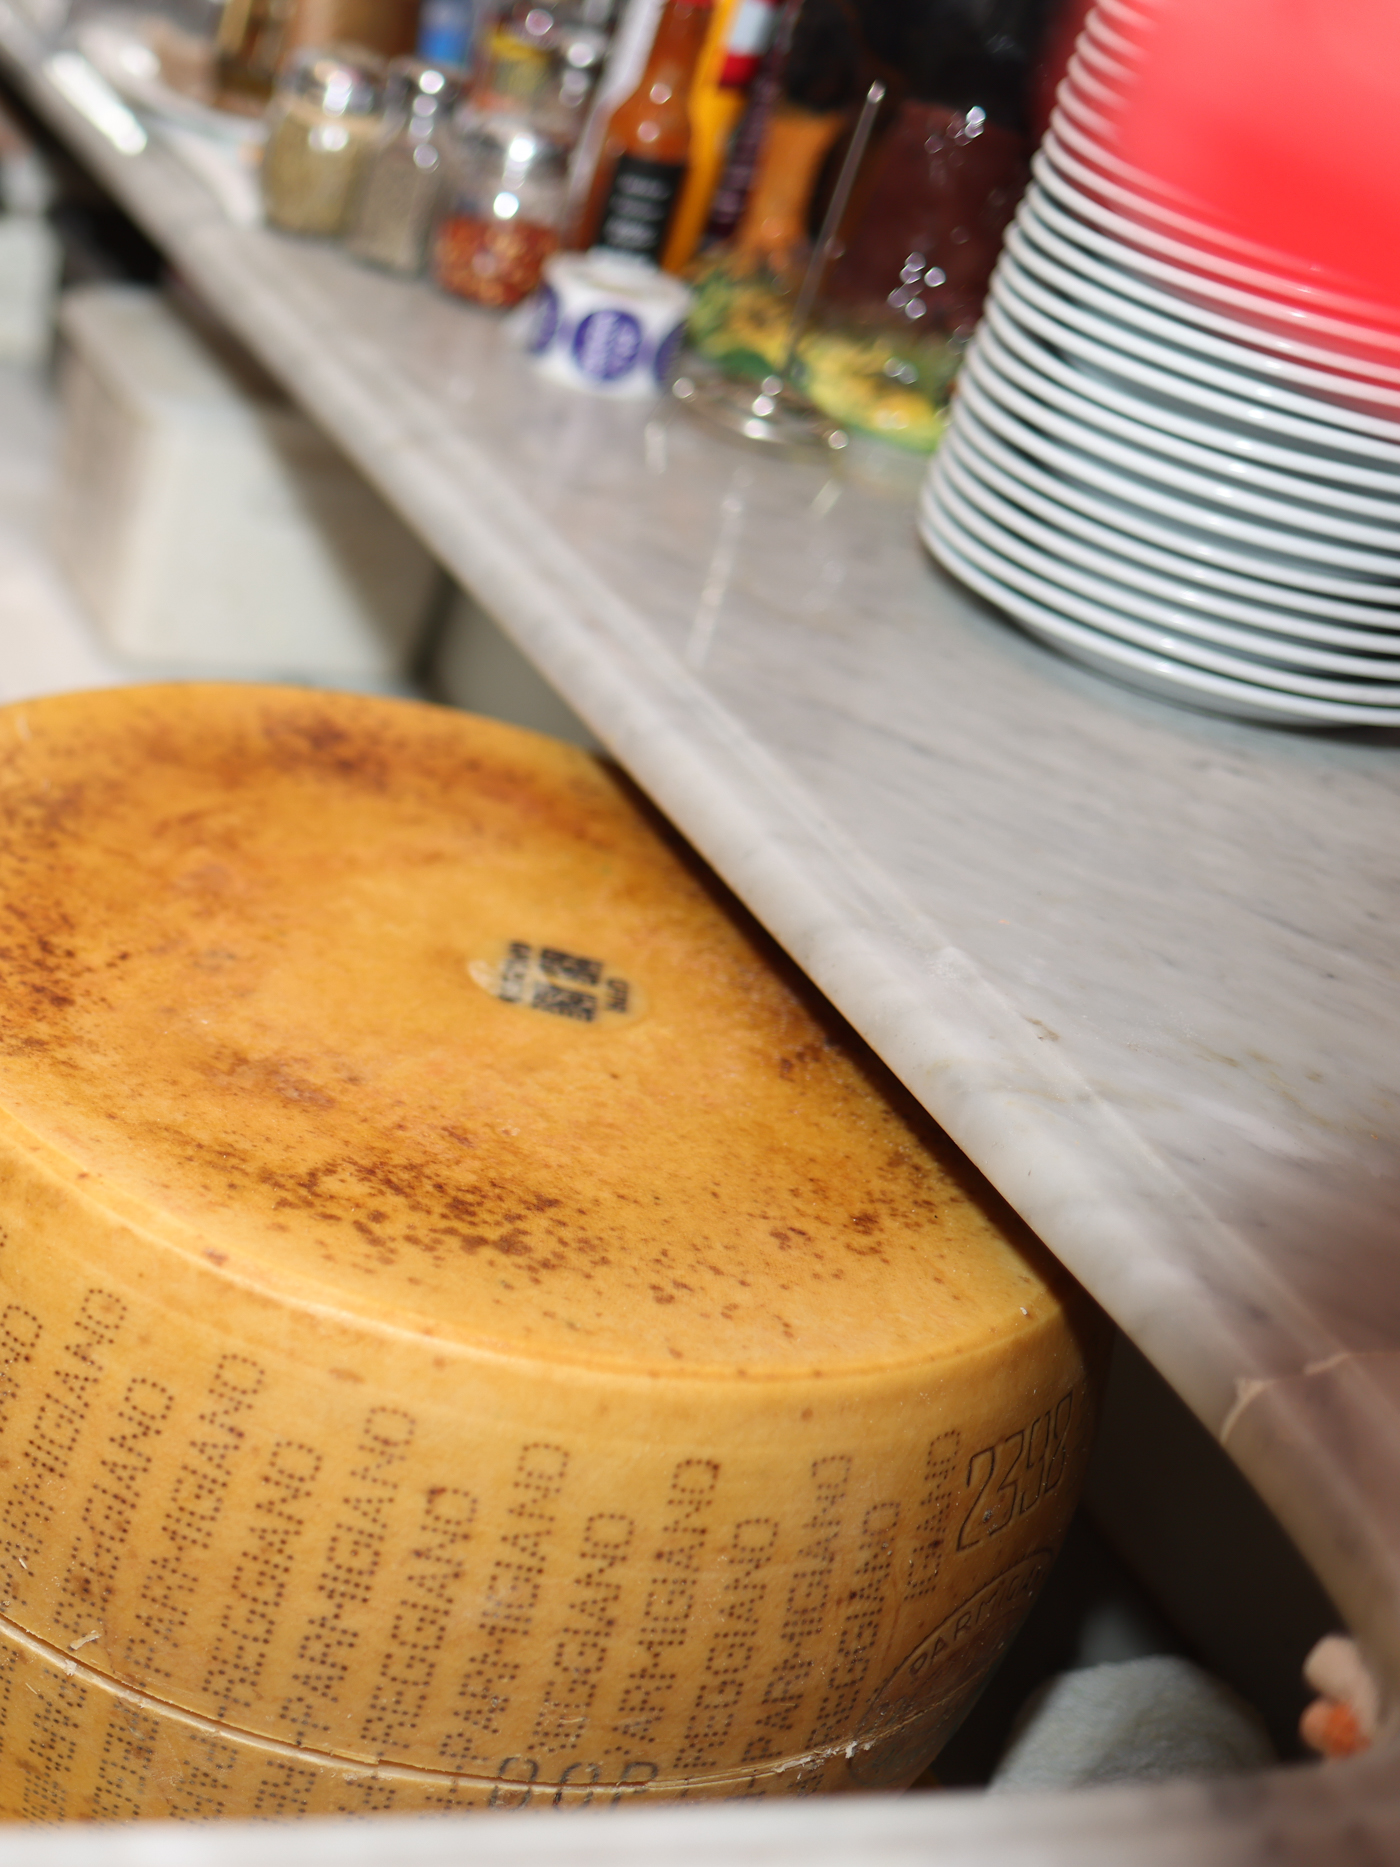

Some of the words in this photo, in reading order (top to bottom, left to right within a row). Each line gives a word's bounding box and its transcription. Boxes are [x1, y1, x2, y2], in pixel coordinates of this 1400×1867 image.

[123, 1354, 266, 1678] PARMIGIANO
[202, 1440, 323, 1707] REGGIANO
[280, 1407, 416, 1731] PARMIGIANO
[360, 1486, 478, 1749] REGGIANO
[439, 1443, 570, 1762] PARMIGIANO
[604, 1459, 722, 1756] ARMIGIANO
[671, 1517, 780, 1768] REGGIANO
[742, 1454, 854, 1762] PARMIGIANO
[802, 1501, 901, 1753] REGGIANO
